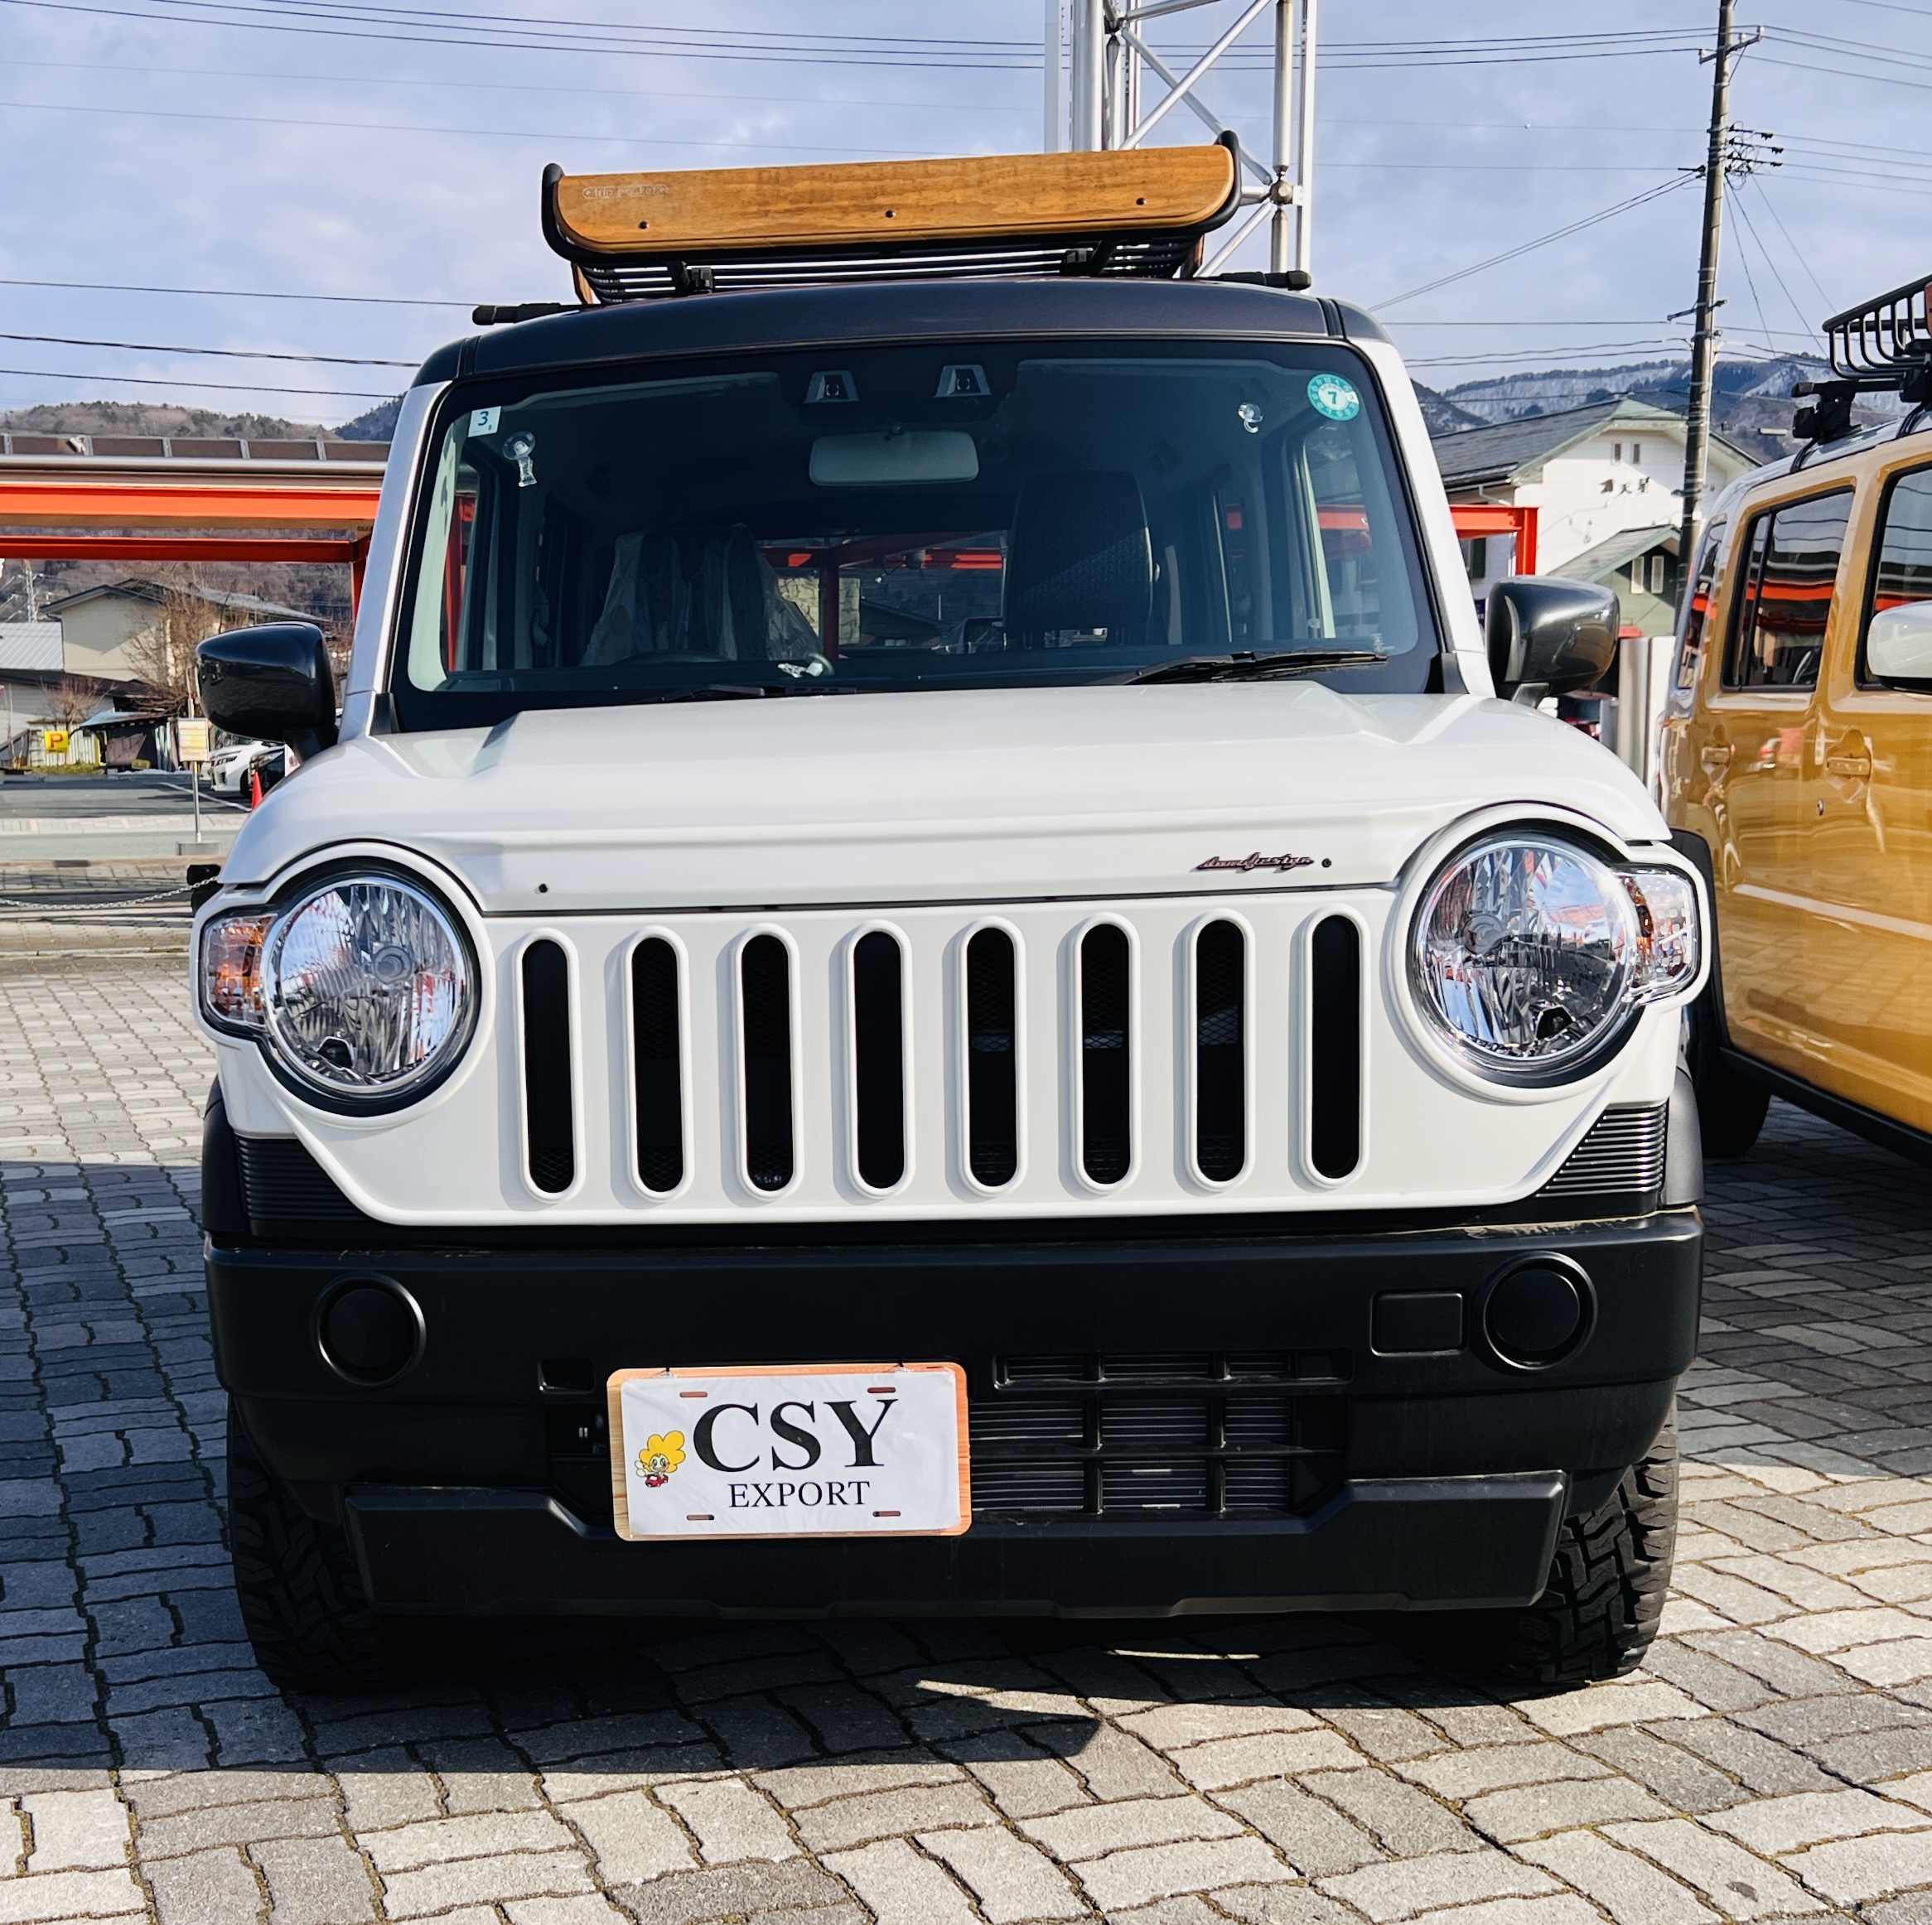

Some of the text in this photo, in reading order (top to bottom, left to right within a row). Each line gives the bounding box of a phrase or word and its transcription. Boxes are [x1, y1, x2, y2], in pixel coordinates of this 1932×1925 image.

[1327, 391, 1336, 405] 7
[477, 411, 489, 427] 3
[51, 733, 64, 749] P
[693, 1398, 899, 1472] CSY
[727, 1481, 871, 1508] EXPORT
